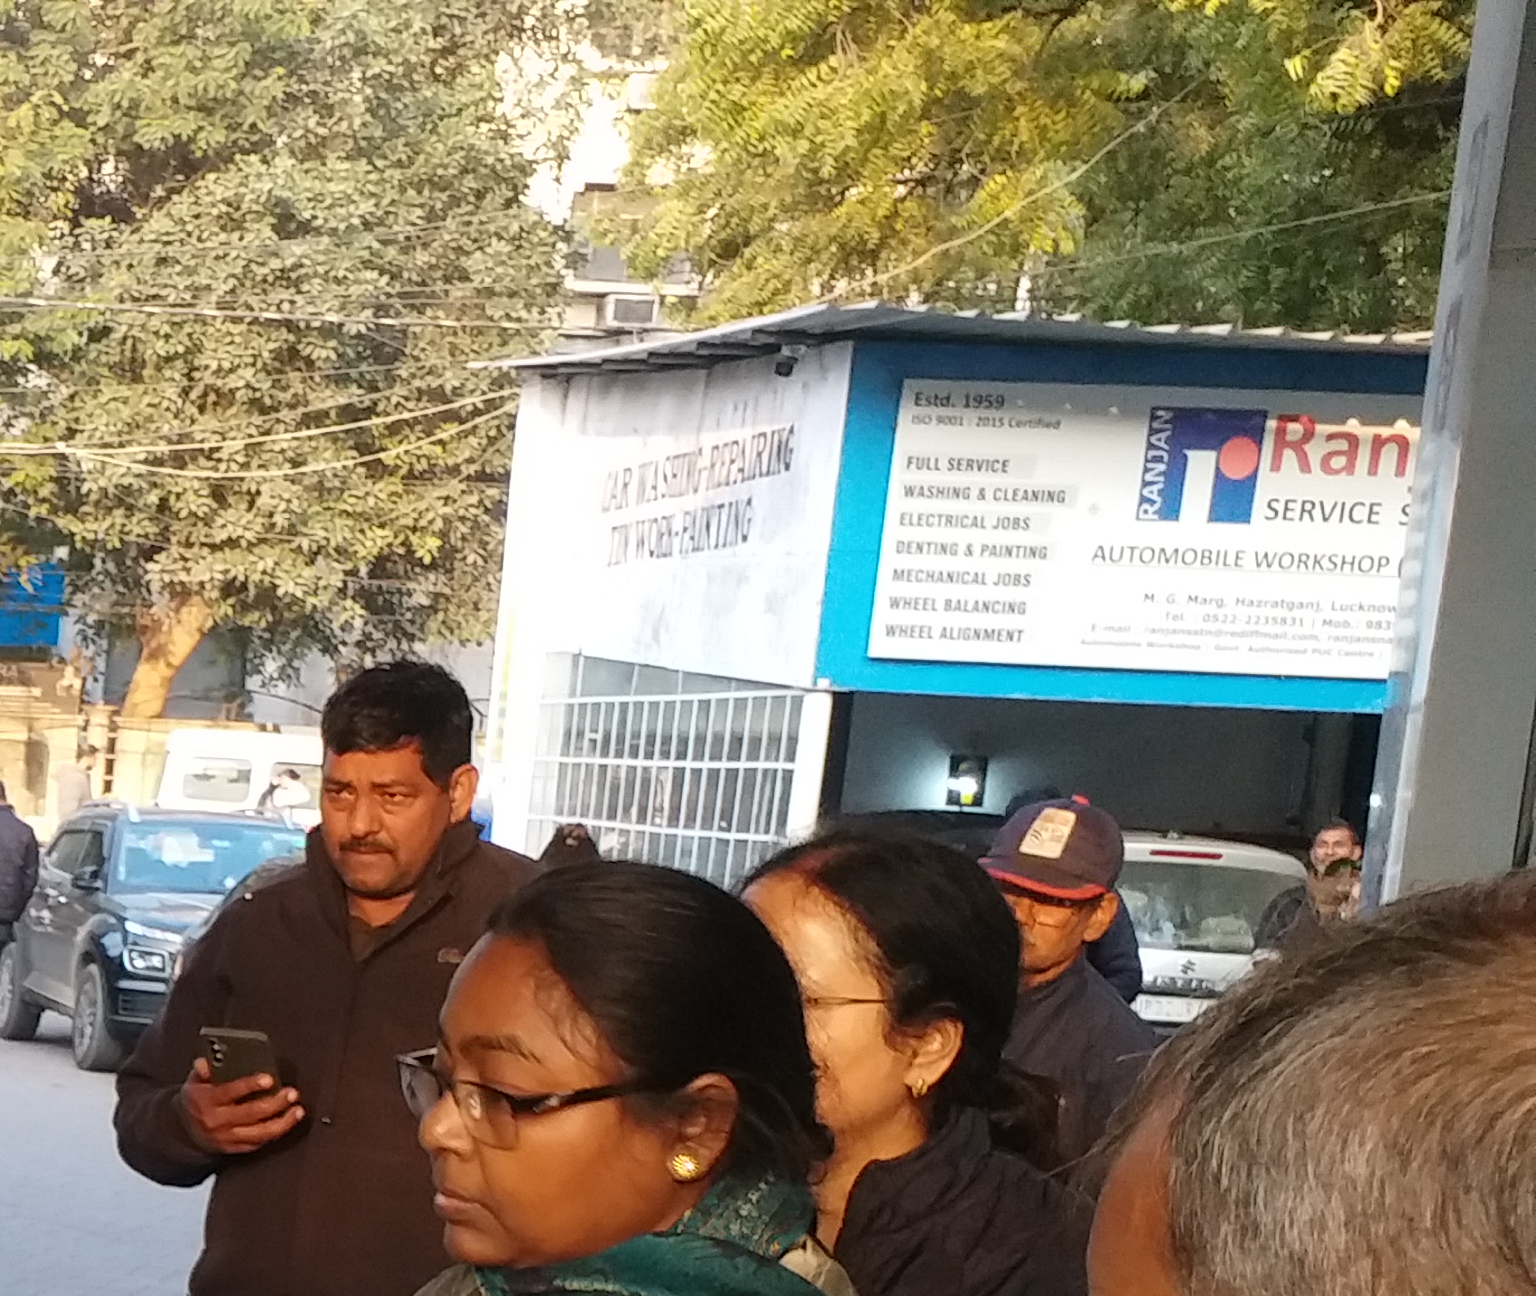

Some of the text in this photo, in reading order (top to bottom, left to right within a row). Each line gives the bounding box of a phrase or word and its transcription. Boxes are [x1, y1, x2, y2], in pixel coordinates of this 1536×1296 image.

[914, 391, 1005, 411] Estd. 1959
[911, 414, 933, 426] ISO
[975, 416, 1005, 428] 2015
[1007, 417, 1062, 430] Certified
[1269, 413, 1413, 482] Ran
[906, 456, 1010, 474] FULL SERVICE
[1138, 408, 1175, 520] RANJAN
[903, 484, 1066, 504] WASHING & CLEANING
[1264, 498, 1383, 525] SERVICE
[899, 512, 1031, 532] ELECTRICAL JOBS
[895, 539, 1048, 561] DENTING & PAINTING
[1091, 544, 1246, 569] AUTOMOBILE
[1254, 550, 1391, 575] WORKSHOP
[892, 568, 1032, 588] MECHANICAL JOBS
[889, 595, 1027, 615] WHEEL BALANCING
[885, 623, 1024, 644] WHEEL ALIGNMENT
